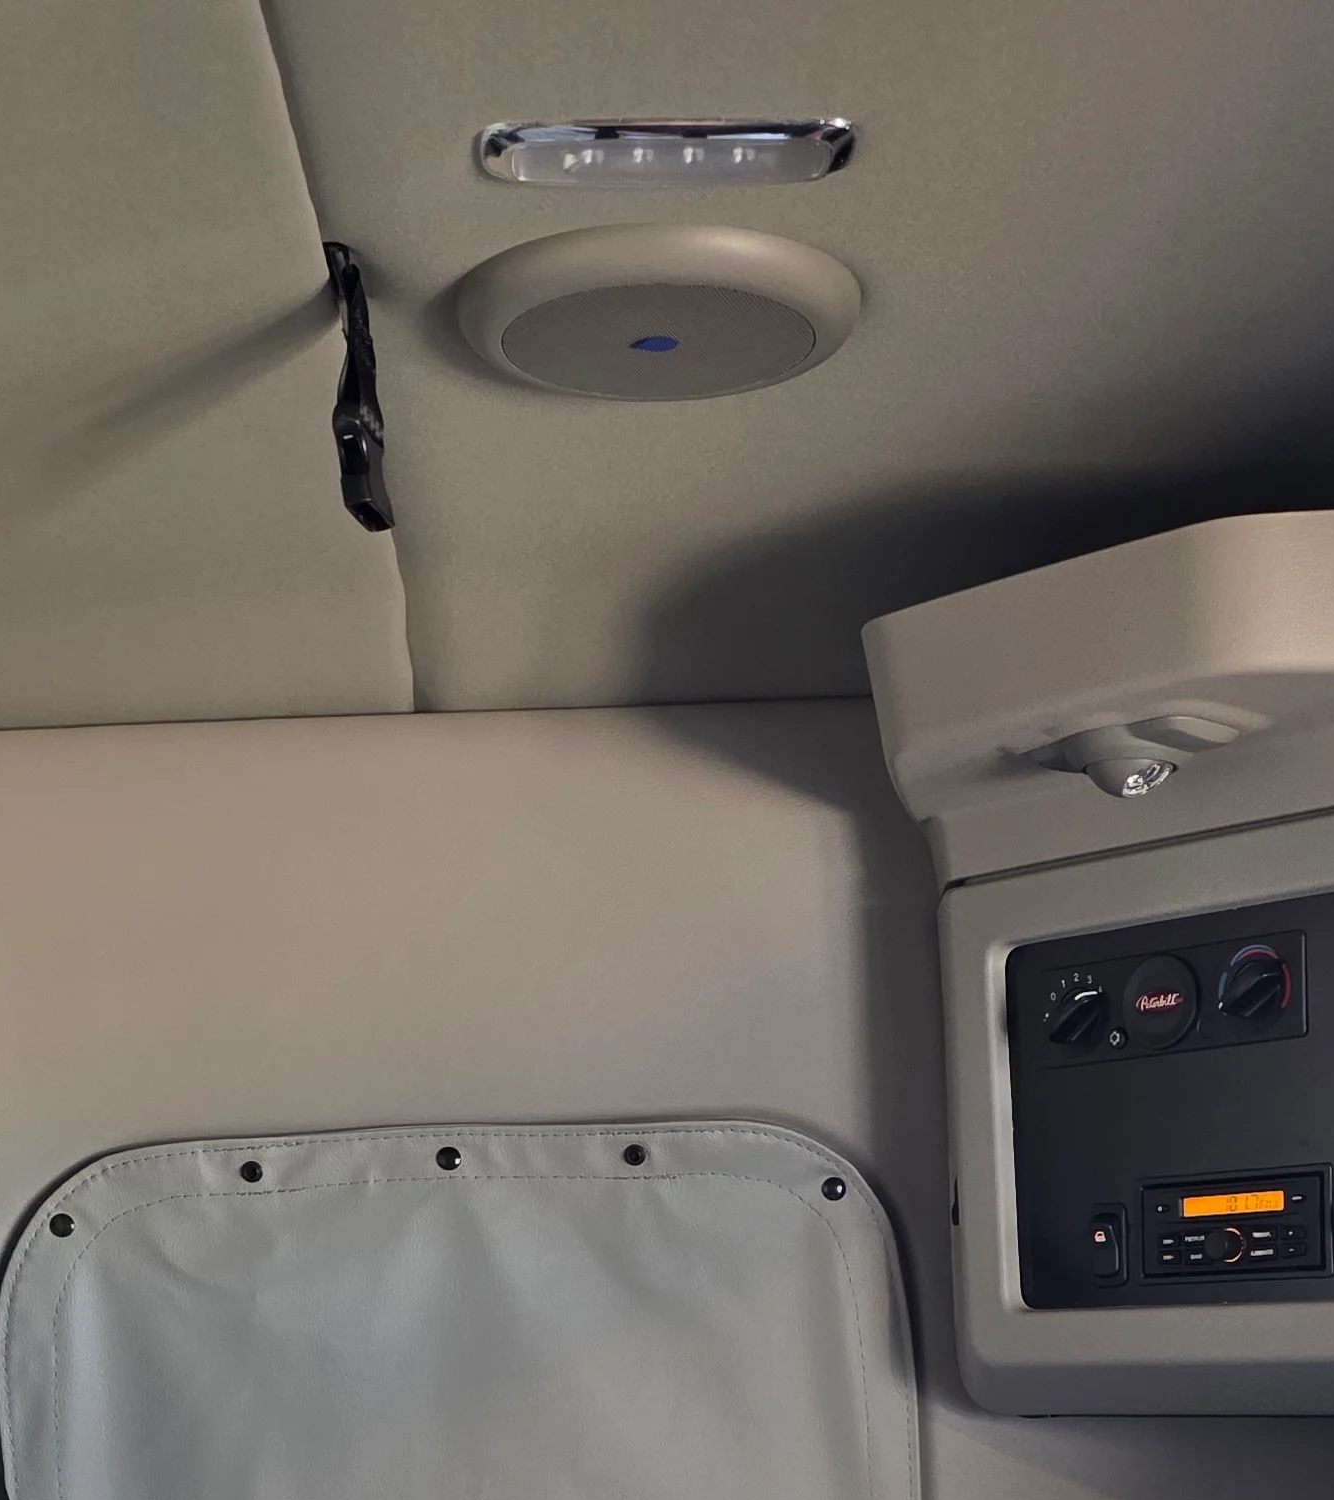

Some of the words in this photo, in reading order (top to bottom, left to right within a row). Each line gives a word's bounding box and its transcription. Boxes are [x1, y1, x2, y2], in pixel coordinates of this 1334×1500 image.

[1073, 973, 1079, 982] 2
[1086, 975, 1093, 984] 3
[1139, 993, 1181, 1011] Peterbilt
